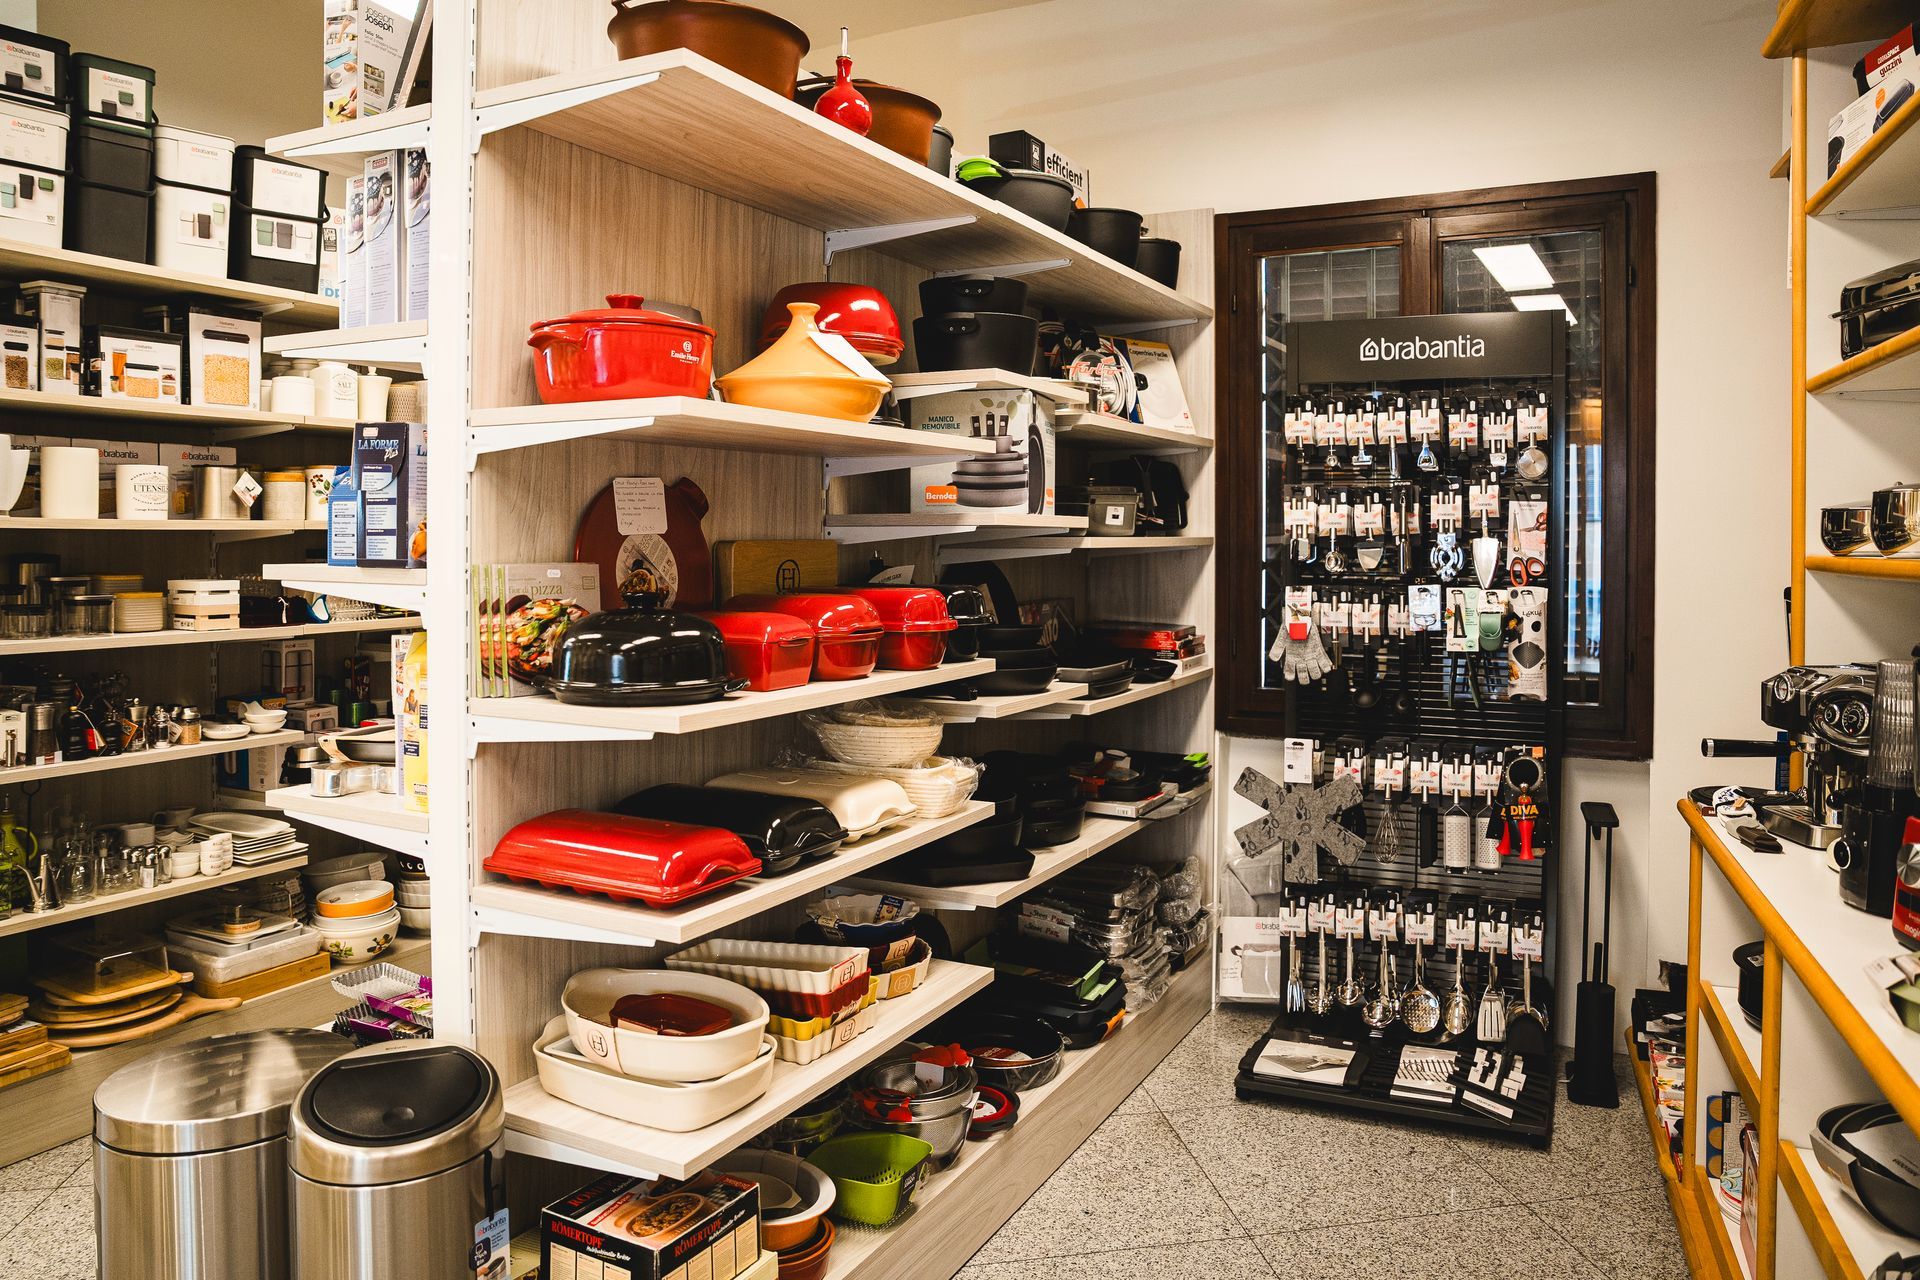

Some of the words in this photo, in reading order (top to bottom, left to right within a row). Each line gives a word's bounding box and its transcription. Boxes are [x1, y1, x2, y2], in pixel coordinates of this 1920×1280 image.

[1879, 55, 1903, 78] guzzini
[1046, 152, 1083, 188] efficient
[1380, 334, 1485, 361] brabantia
[928, 415, 954, 423] MANICO
[922, 422, 960, 430] REMOVIBILE
[358, 439, 370, 450] LA
[369, 439, 399, 450] FORME
[103, 448, 139, 459] brabantia
[188, 450, 220, 461] brabantia
[926, 492, 957, 500] Berndes
[530, 581, 563, 600] pizza
[1510, 804, 1539, 815] DIVA
[1261, 920, 1281, 930] braba
[551, 1220, 604, 1247] RÖMERTOPF
[674, 1218, 722, 1257] RÖMERTOPF
